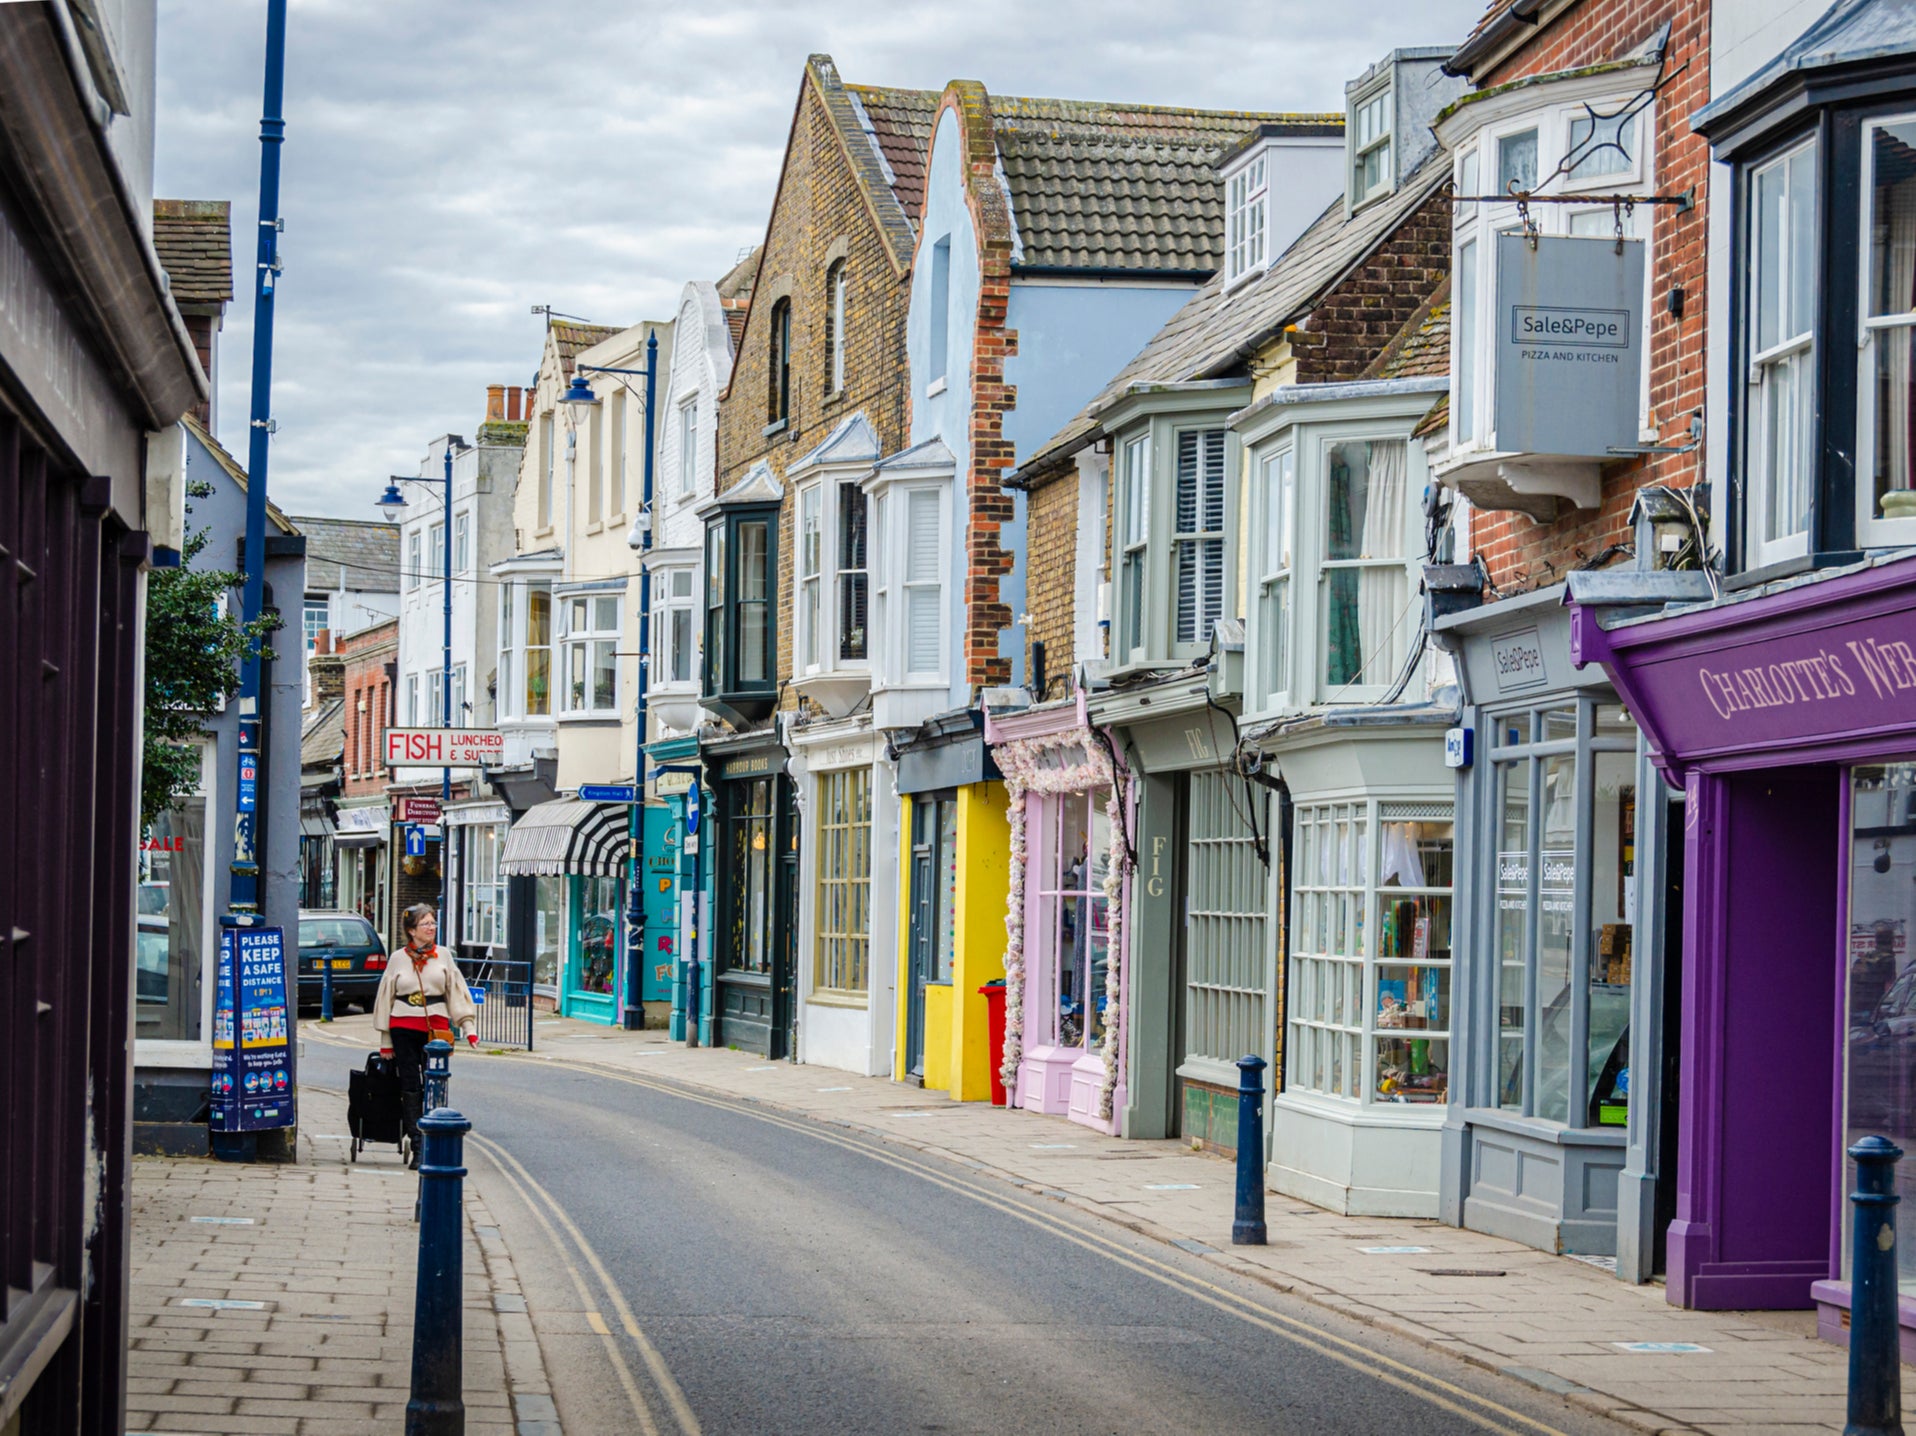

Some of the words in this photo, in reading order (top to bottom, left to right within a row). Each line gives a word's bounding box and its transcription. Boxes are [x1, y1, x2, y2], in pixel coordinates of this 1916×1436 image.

[1523, 316, 1618, 339] Sale&Pepe
[1521, 350, 1549, 360] PIZZA
[1552, 351, 1574, 361] AND
[1576, 352, 1618, 363] KITCHEN
[1496, 647, 1540, 675] Sale&Pepe
[1699, 649, 1855, 720] CHARLOTTE'S
[389, 733, 442, 761] FISH
[451, 734, 503, 747] LUNCHEO
[1184, 727, 1209, 759] FIG
[725, 760, 749, 775] HARBOUR
[751, 757, 768, 772] BOOKS
[1147, 836, 1167, 897] FIG
[1543, 862, 1574, 885] Sale&Pepe
[242, 935, 279, 946] PLEASE
[242, 947, 280, 962] KEEP
[243, 965, 251, 975] A
[253, 963, 281, 975] SAFE
[243, 977, 281, 986] DISTANCE
